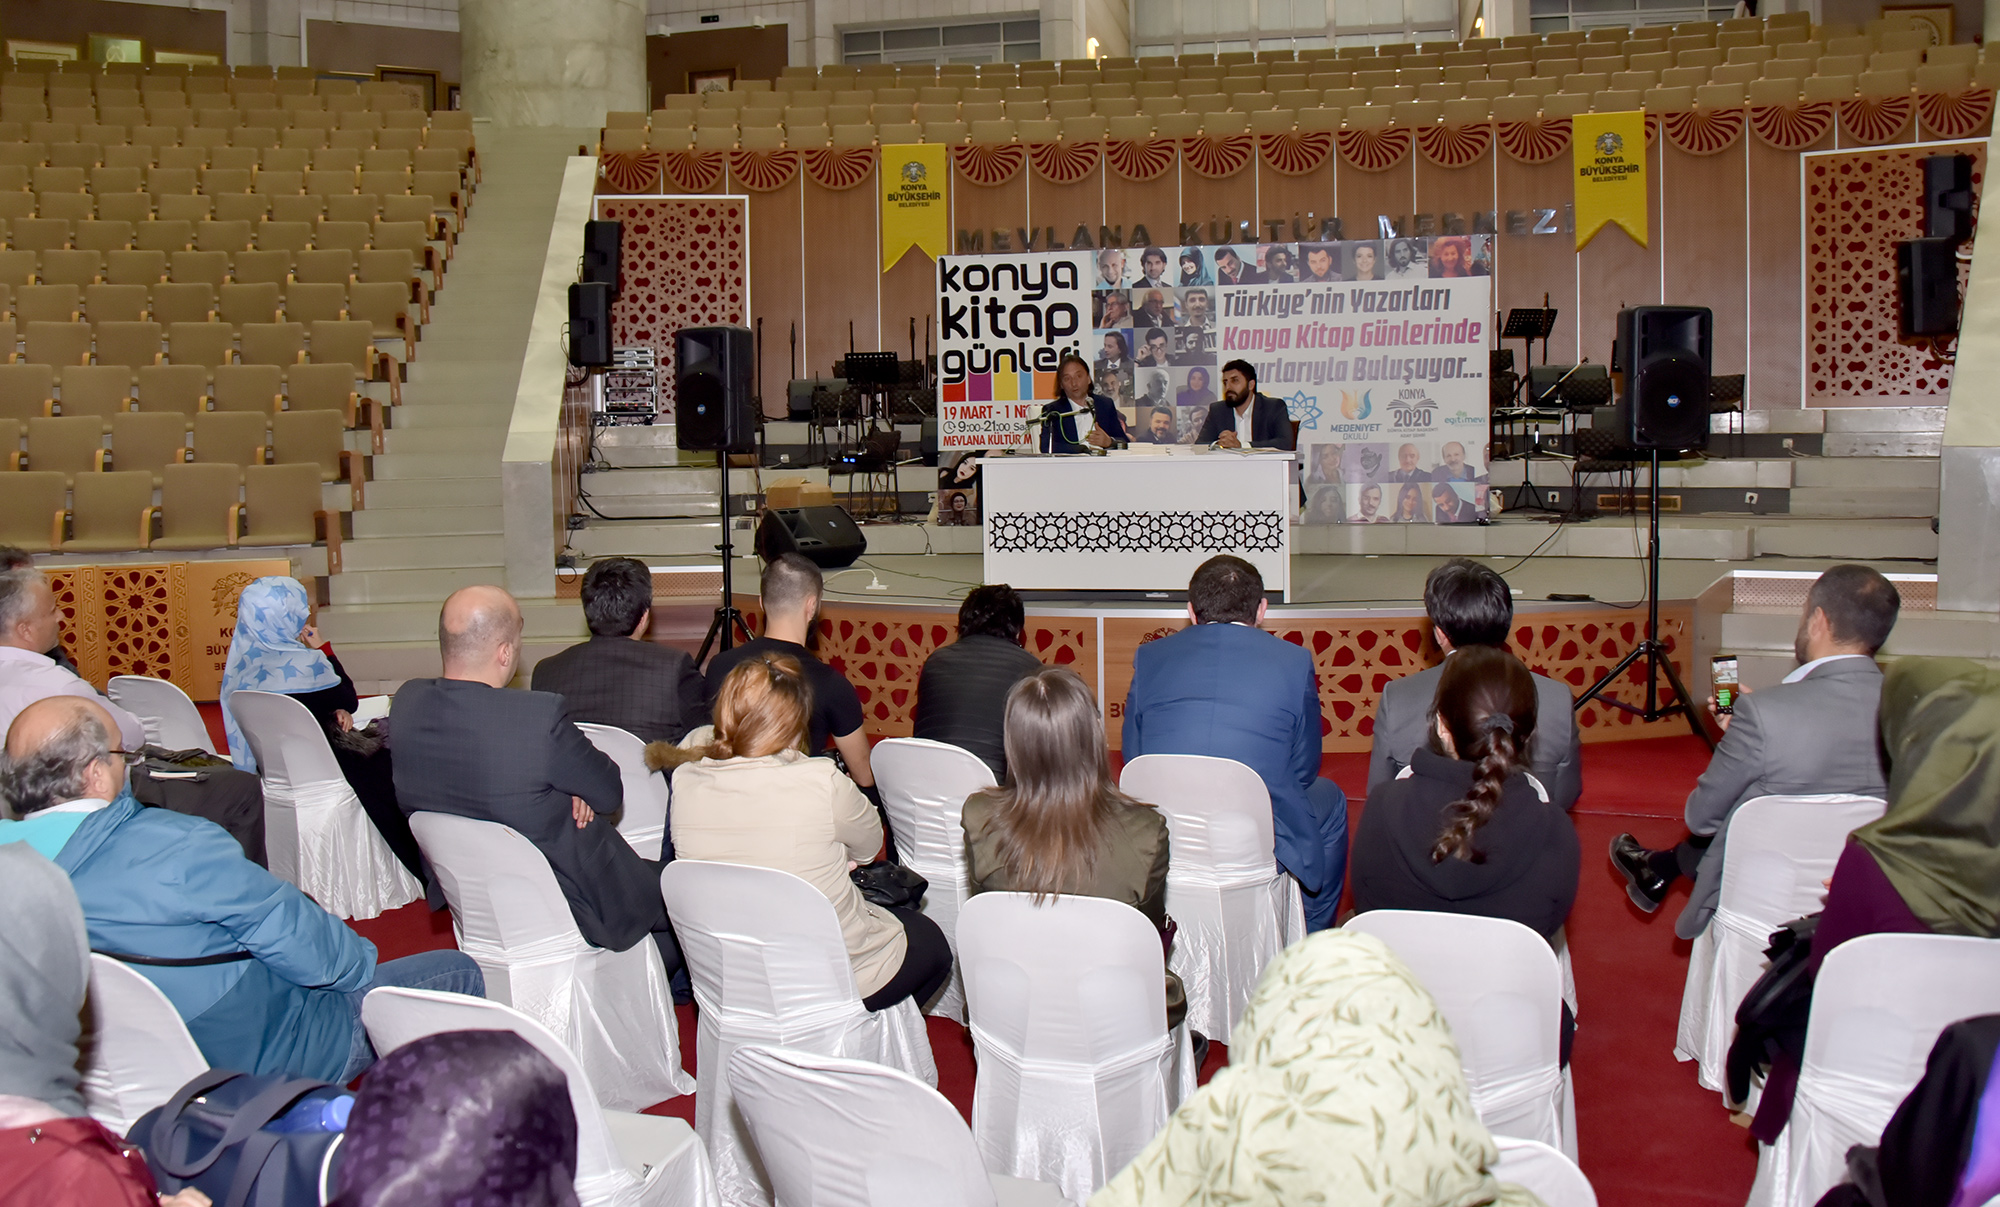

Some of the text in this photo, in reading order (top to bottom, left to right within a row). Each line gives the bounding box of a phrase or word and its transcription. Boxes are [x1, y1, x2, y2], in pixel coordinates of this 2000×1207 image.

[1580, 164, 1640, 176] BÜYÜKŞEHİR
[887, 191, 941, 201] BÜYÜKŞEHİR
[1179, 212, 1344, 245] KÜLTÜR
[1378, 203, 1574, 239] MERKEZİ
[939, 257, 1078, 301] konya
[1350, 285, 1451, 313] Yazarları
[940, 295, 1079, 345] kitap
[1223, 317, 1481, 352] Konya Kitap Günlerinde
[1398, 388, 1426, 399] KONYA
[943, 406, 957, 420] 19
[960, 405, 993, 419] MART
[1005, 405, 1010, 418] 1
[1394, 408, 1432, 427] 2020
[943, 434, 985, 446] MEVLANA
[988, 431, 1021, 445] KÜLTÜR
[1342, 432, 1369, 440] OKULU
